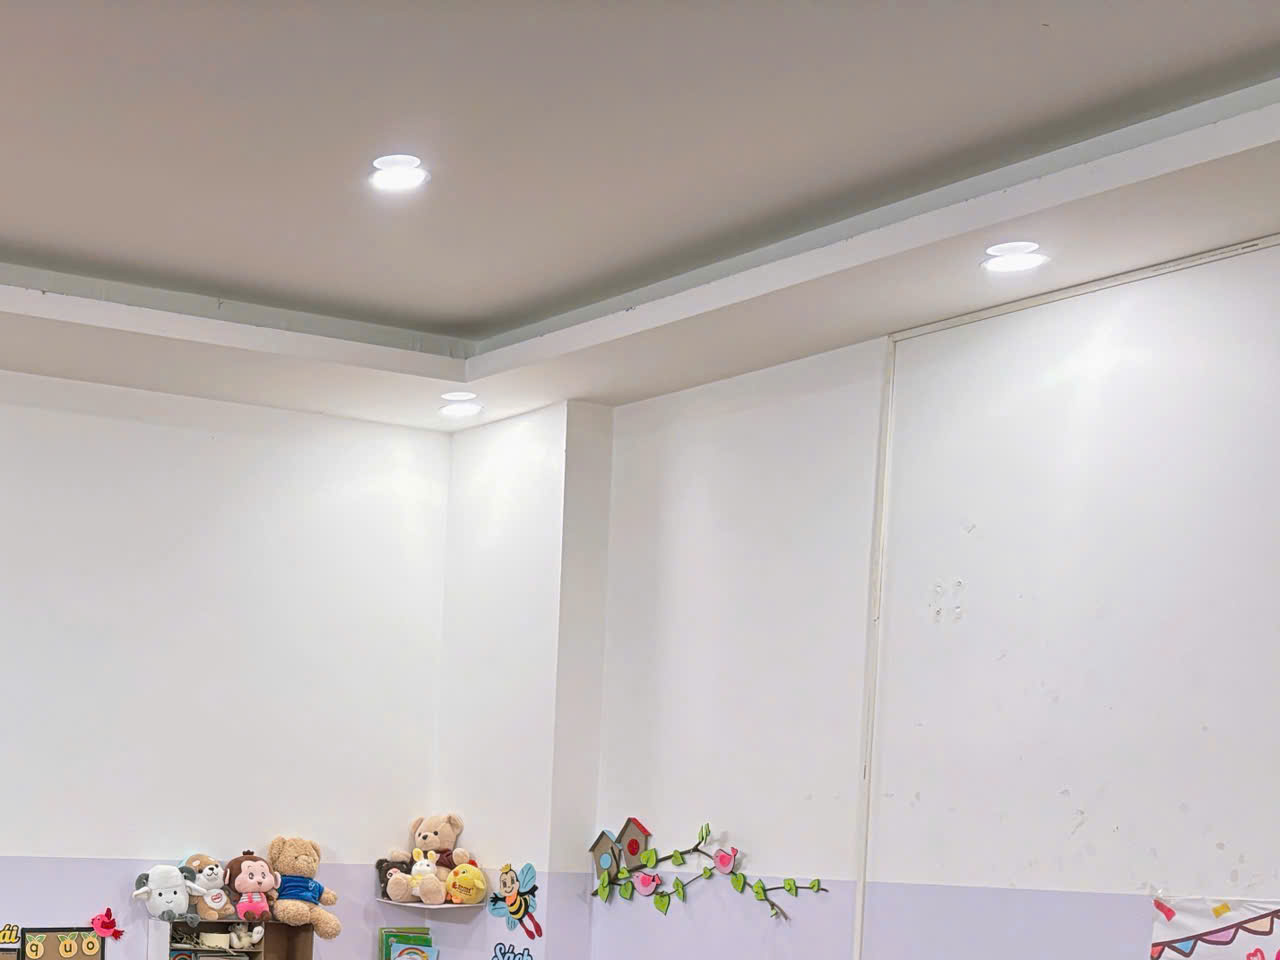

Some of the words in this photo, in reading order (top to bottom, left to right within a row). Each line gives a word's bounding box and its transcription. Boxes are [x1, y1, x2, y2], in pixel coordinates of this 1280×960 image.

[30, 943, 38, 956] q
[64, 943, 72, 953] u
[86, 941, 95, 951] o
